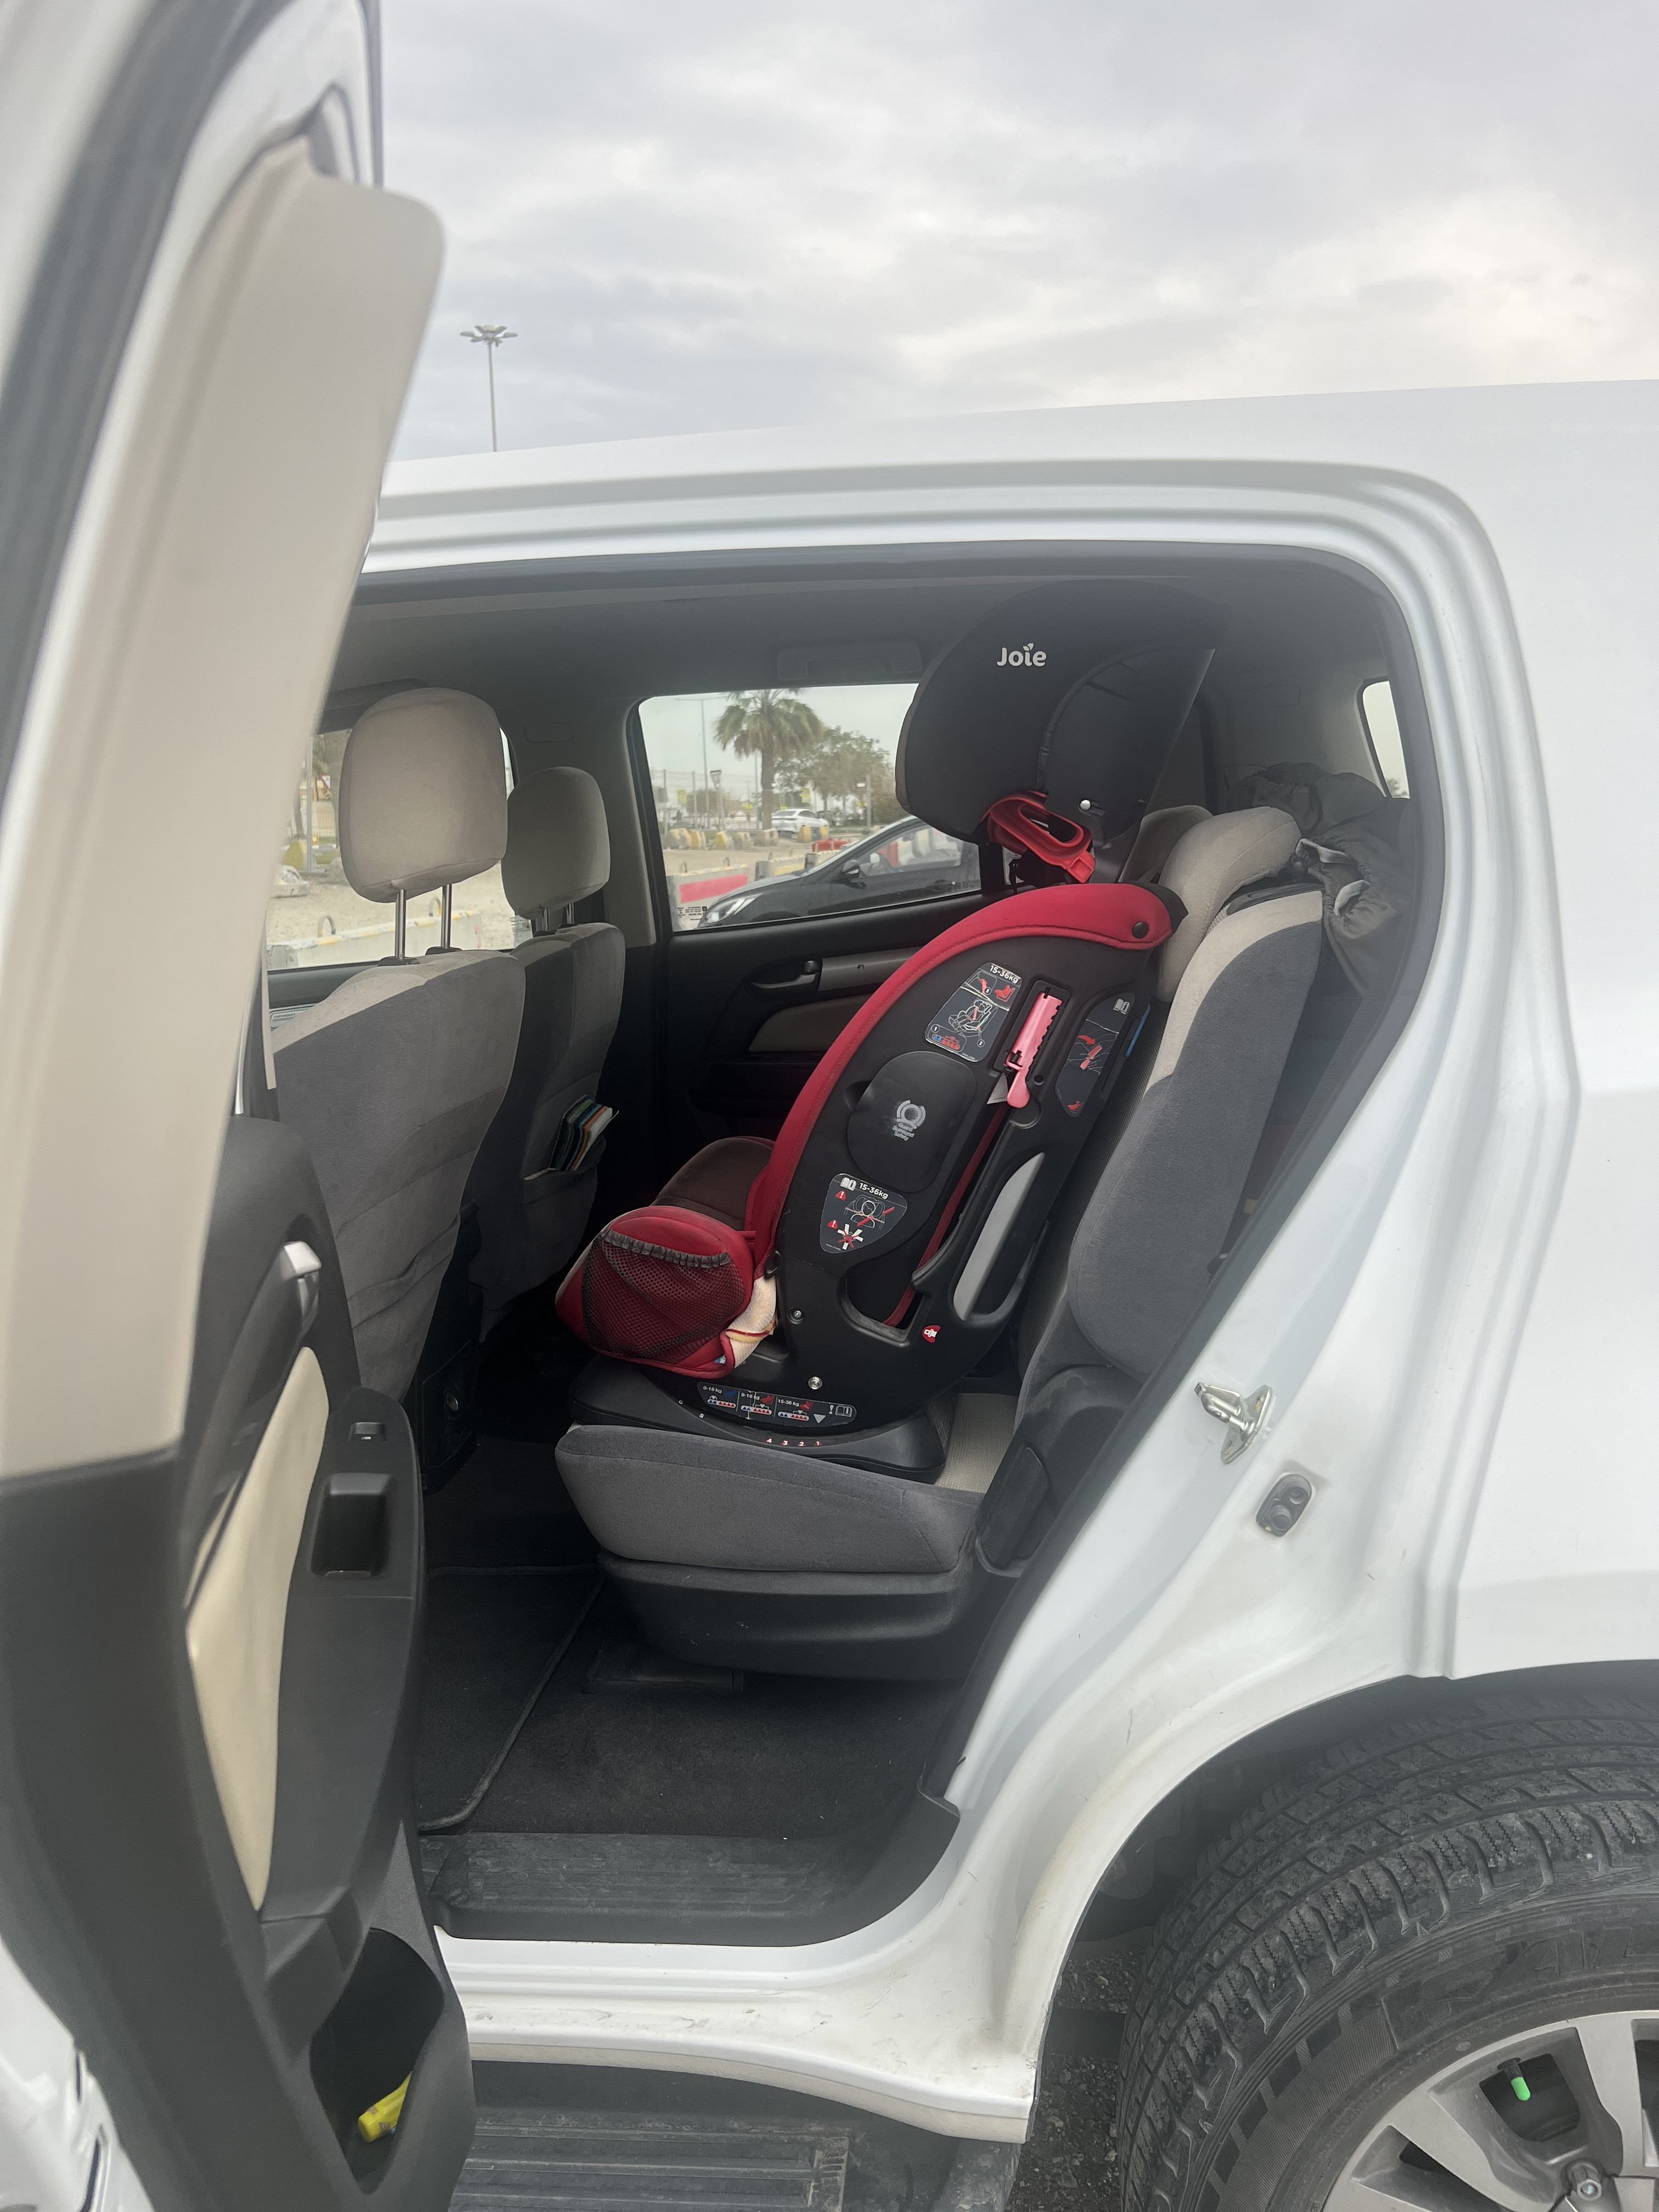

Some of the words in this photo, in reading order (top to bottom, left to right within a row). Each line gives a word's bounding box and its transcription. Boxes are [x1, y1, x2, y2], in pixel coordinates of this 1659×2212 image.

[996, 642, 1047, 667] Joie
[989, 964, 1019, 984] 15-36kg
[892, 1125, 915, 1138] Surround
[898, 1122, 913, 1132] Guard
[893, 1131, 909, 1141] Safety
[859, 1182, 889, 1199] 15-36kg
